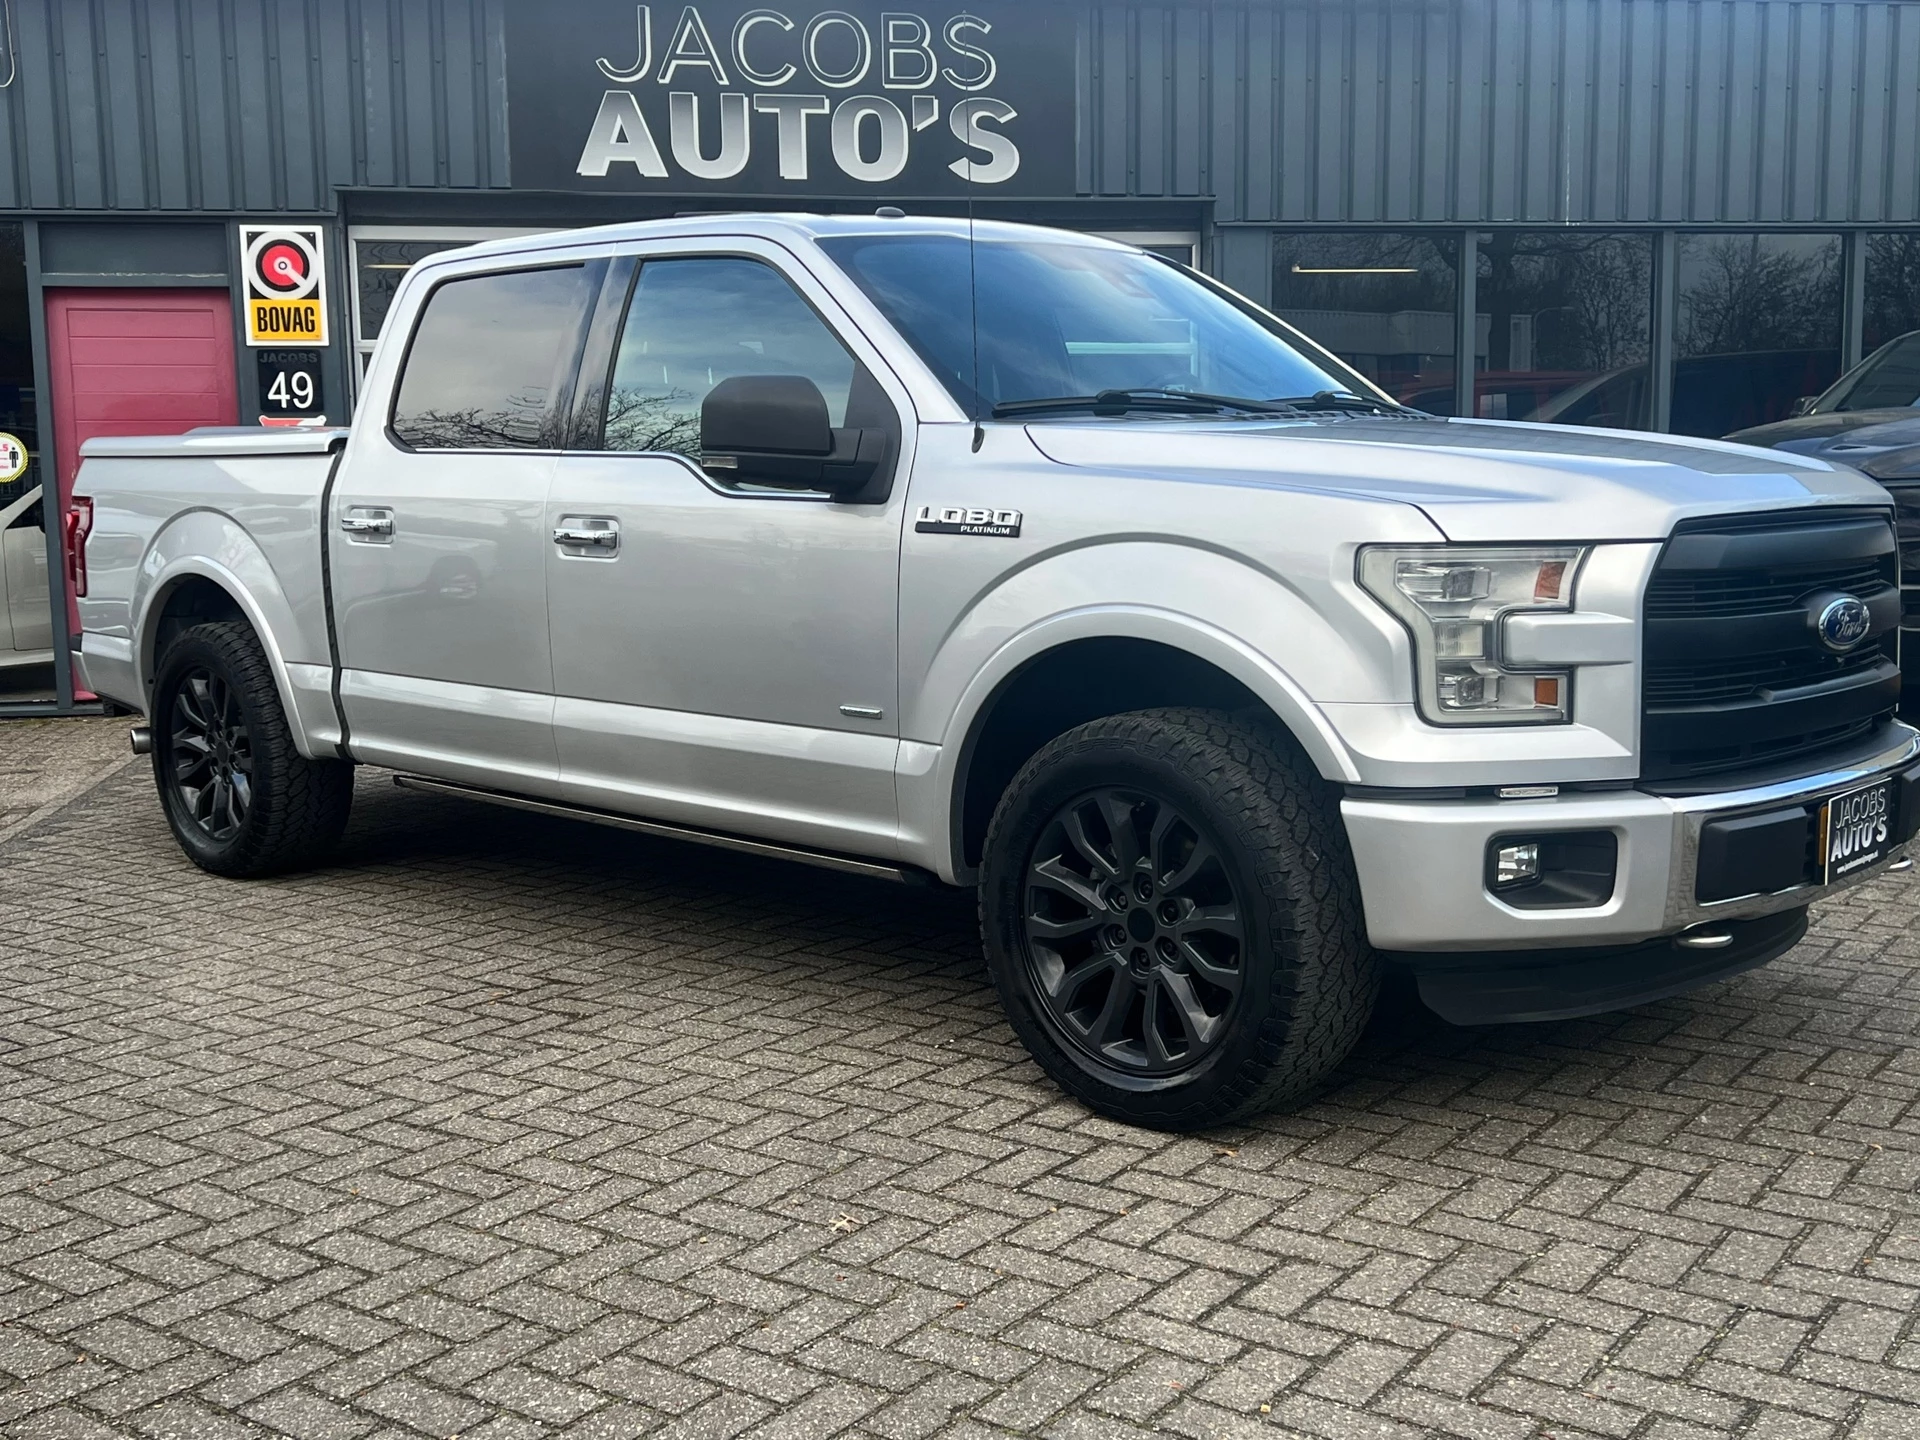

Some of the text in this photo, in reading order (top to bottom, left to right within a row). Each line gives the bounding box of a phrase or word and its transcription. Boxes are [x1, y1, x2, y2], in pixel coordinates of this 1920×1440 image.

[595, 5, 997, 91] JACOBS
[576, 90, 1021, 184] AUTO'S
[256, 306, 316, 333] BOVAG
[259, 352, 318, 363] JACOBS
[267, 371, 314, 409] 49
[915, 506, 1022, 527] LOBO
[960, 525, 1010, 535] PLATINUM
[1835, 787, 1886, 829] JACOBS
[1830, 812, 1888, 862] AUTO'S
